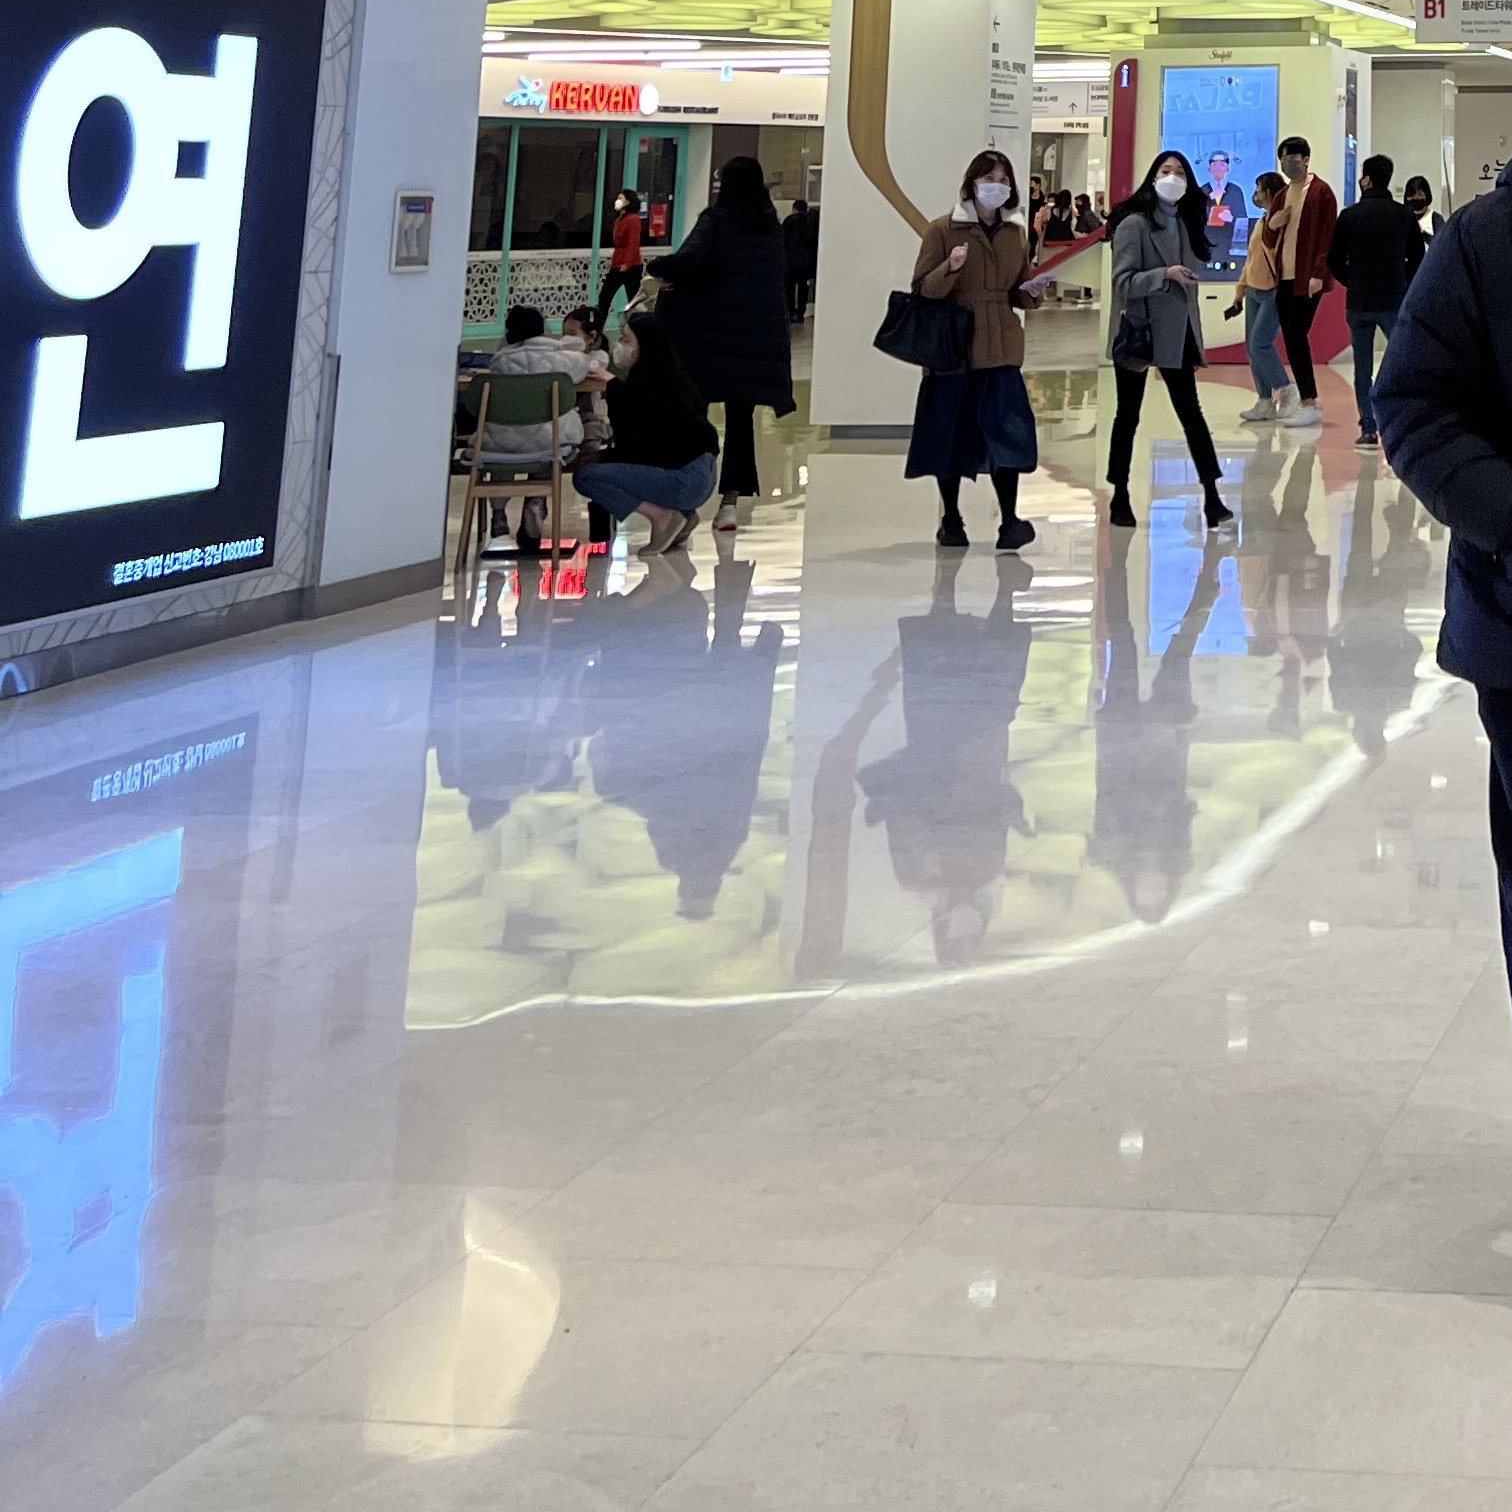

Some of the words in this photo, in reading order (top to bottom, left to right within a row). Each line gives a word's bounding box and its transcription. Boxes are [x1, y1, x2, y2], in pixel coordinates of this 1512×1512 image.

[1461, 0, 1512, 11] 트레이드타워
[550, 80, 640, 113] KERVAN
[17, 26, 258, 520] 연
